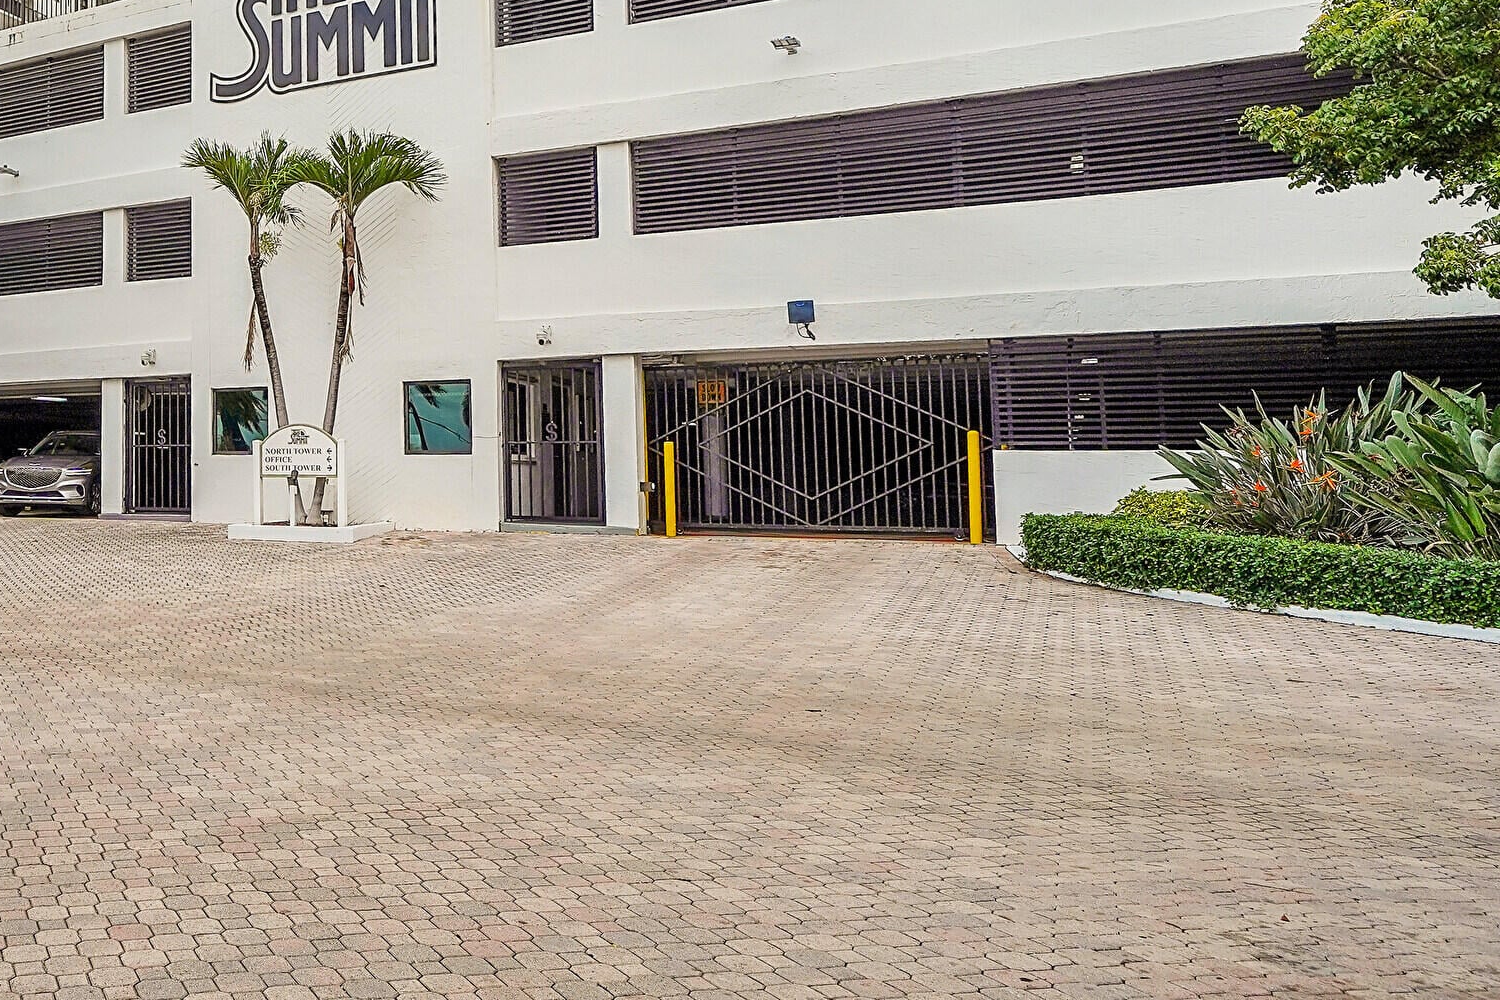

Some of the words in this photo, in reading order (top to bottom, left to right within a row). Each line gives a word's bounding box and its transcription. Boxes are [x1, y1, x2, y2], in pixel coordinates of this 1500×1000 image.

[265, 447, 292, 455] NORTH
[294, 447, 322, 455] TOWER
[264, 456, 293, 464] OFFICE
[265, 464, 291, 472] SOUTH
[294, 464, 321, 472] TOWER
